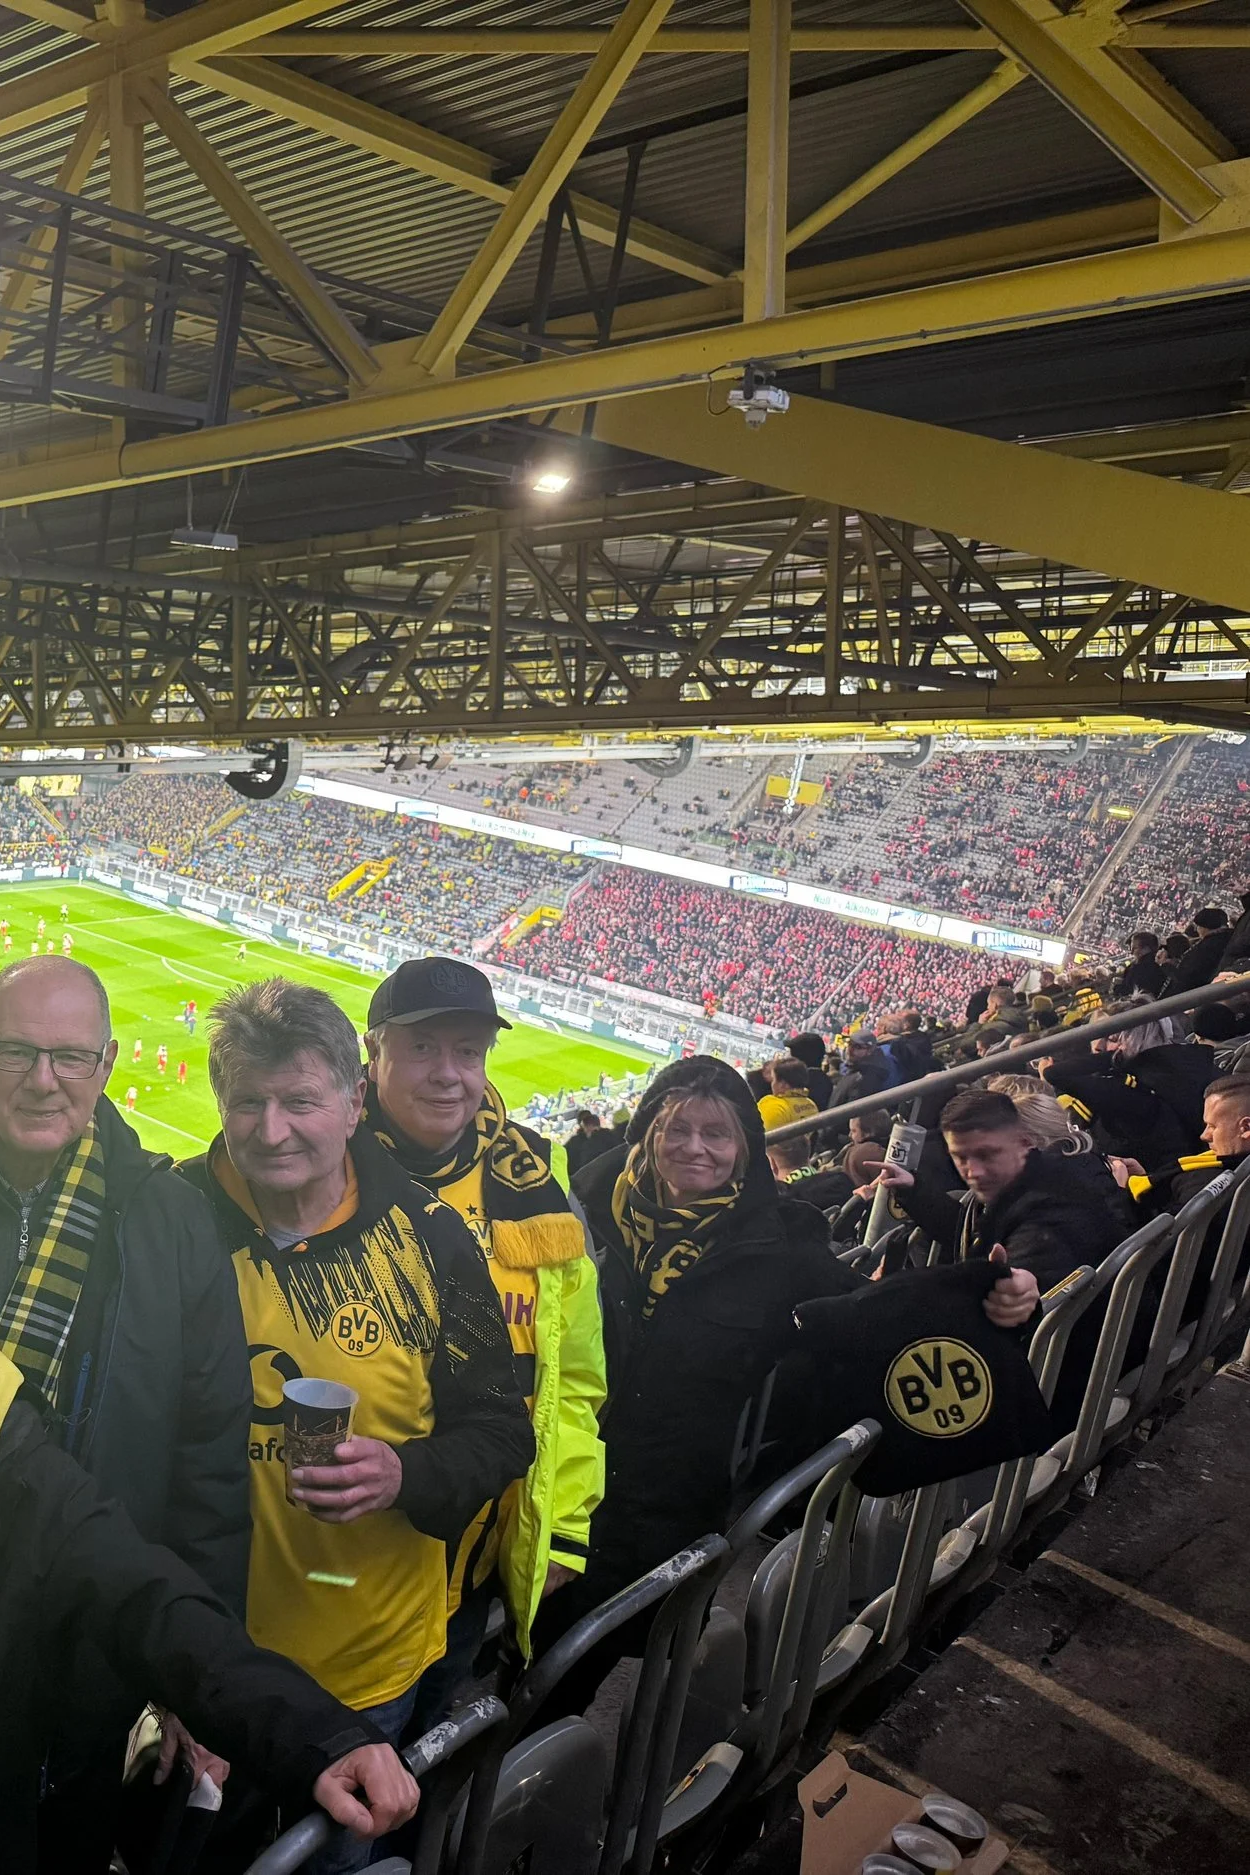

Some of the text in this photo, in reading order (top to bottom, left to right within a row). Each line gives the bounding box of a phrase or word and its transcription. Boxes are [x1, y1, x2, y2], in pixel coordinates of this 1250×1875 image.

[338, 1307, 379, 1344] BVB
[347, 1338, 364, 1352] 09
[896, 1346, 982, 1416] BVB
[933, 1403, 966, 1429] 09
